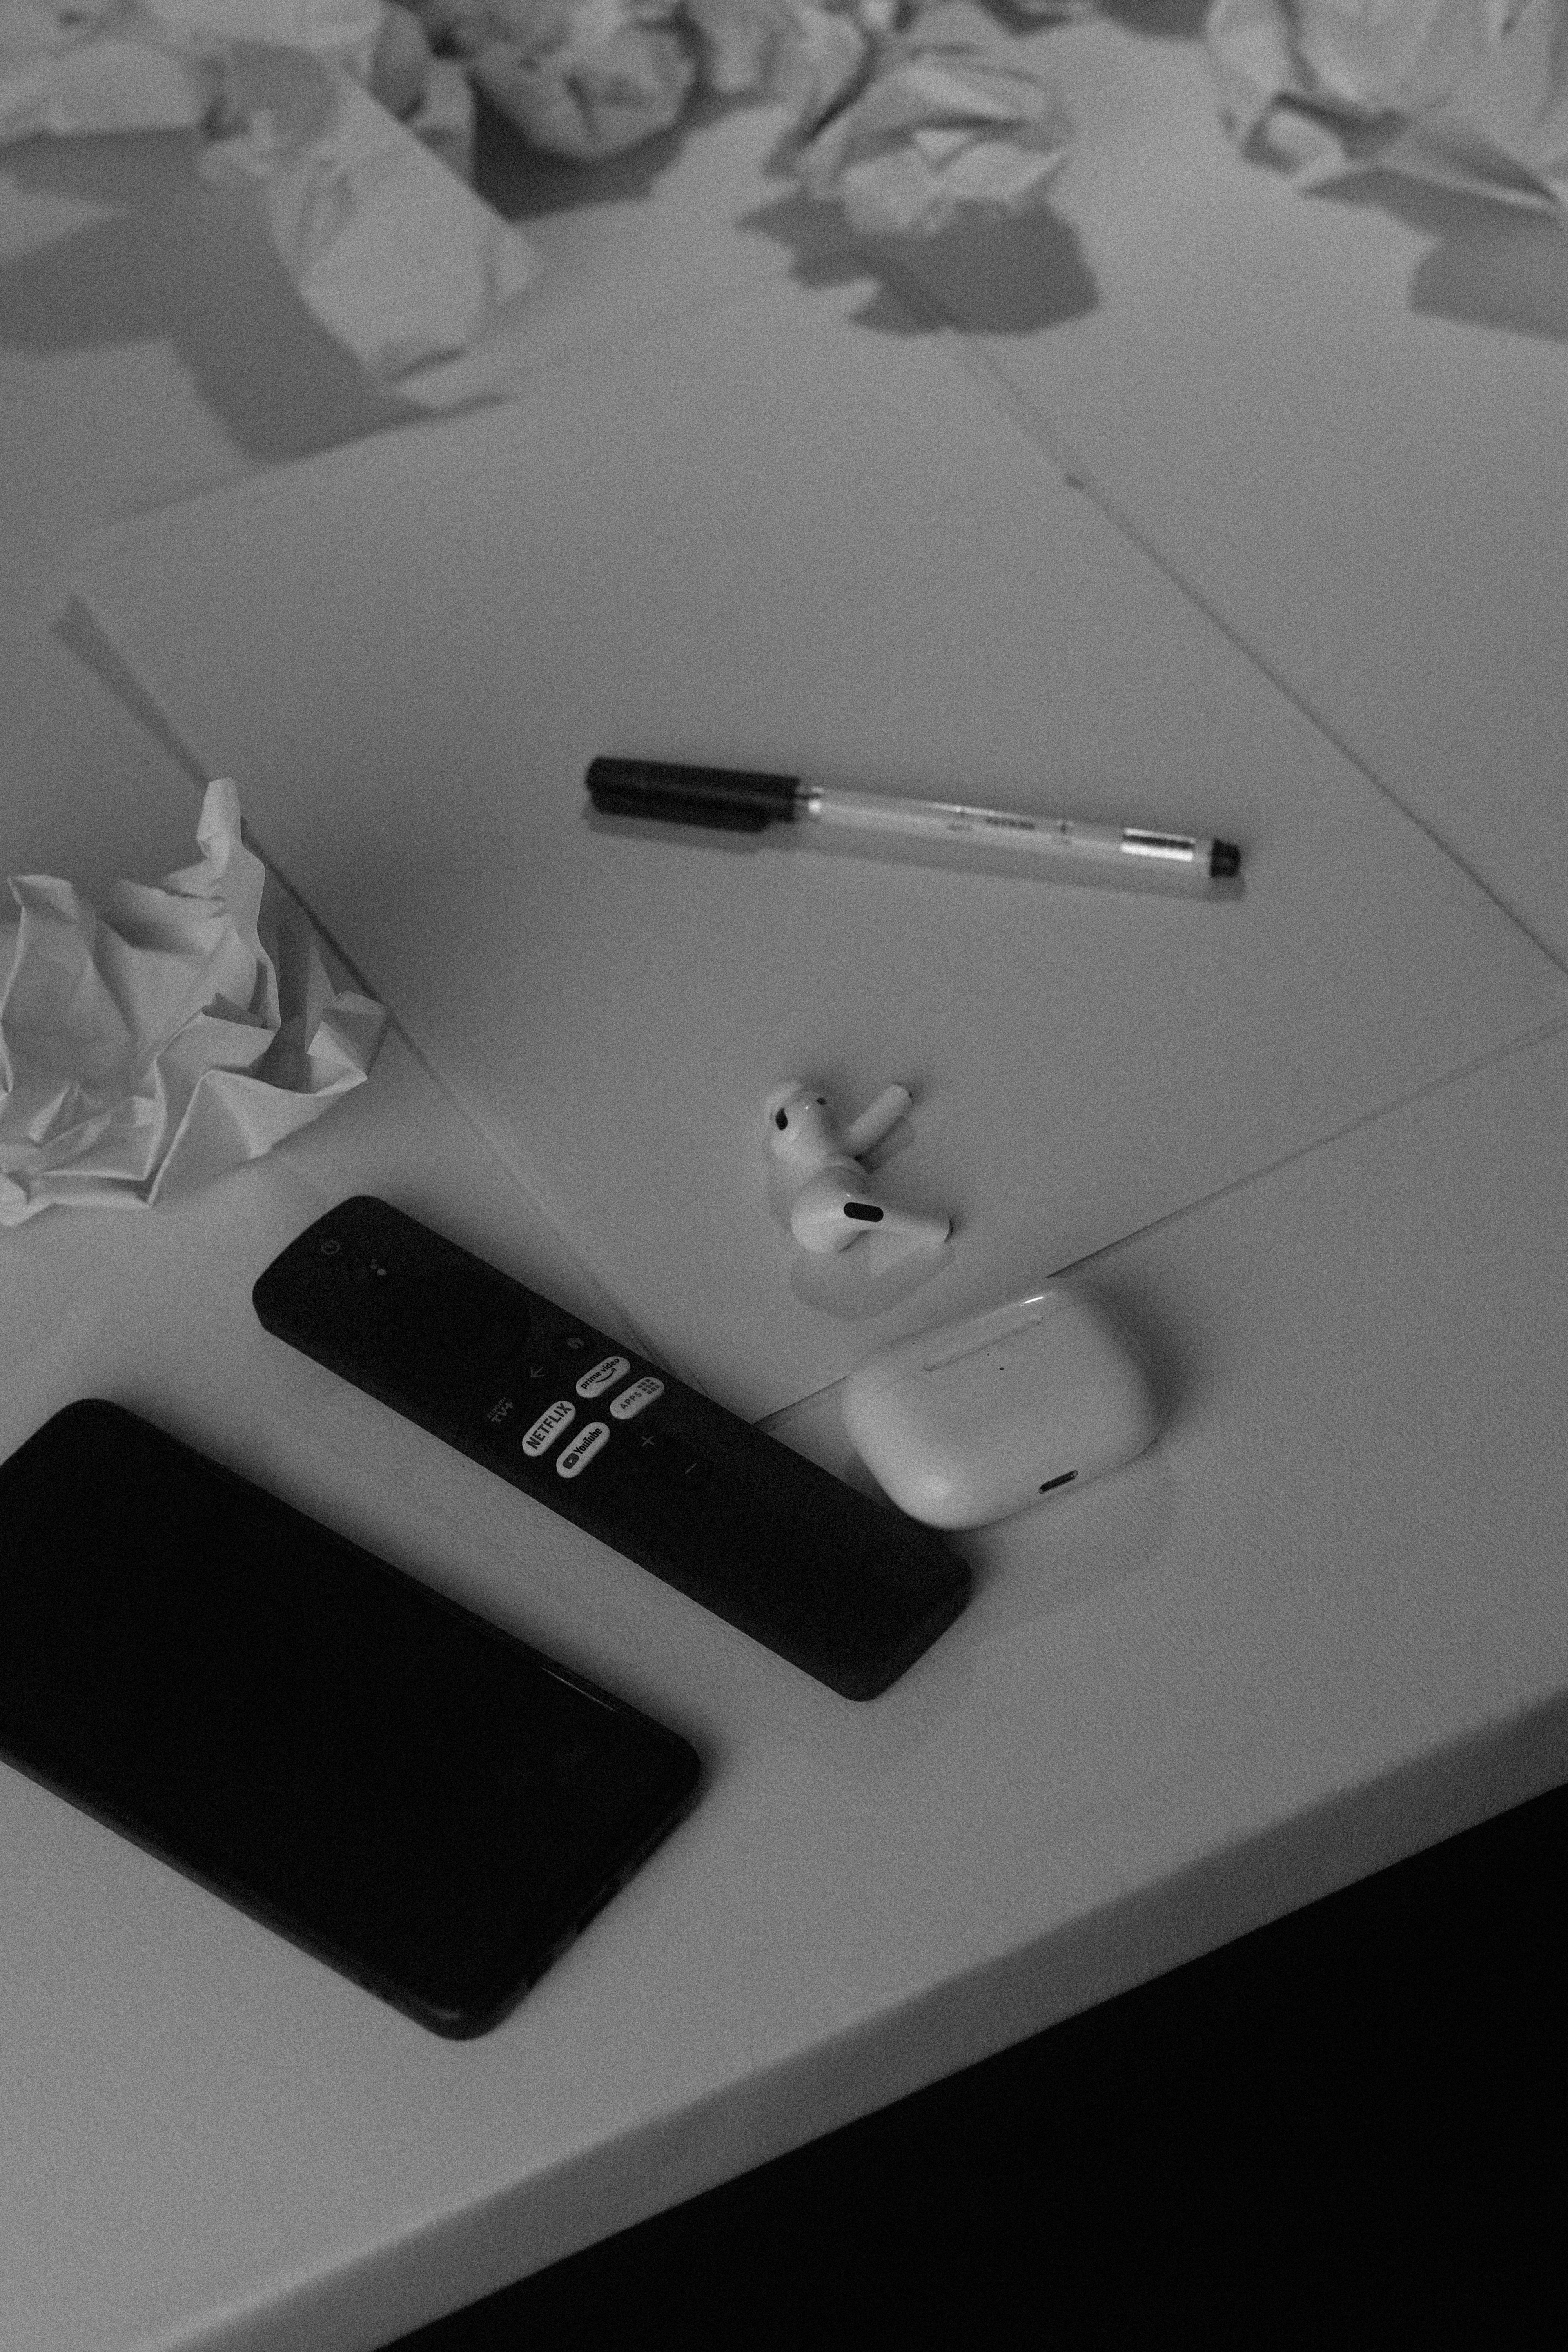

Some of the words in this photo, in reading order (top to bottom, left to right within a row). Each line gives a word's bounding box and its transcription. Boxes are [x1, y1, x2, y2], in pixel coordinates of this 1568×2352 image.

[581, 1372, 602, 1389] prime
[601, 1359, 620, 1372] video
[620, 1391, 642, 1410] APPS
[526, 1403, 572, 1450] NETFLIX
[573, 1428, 603, 1455] YouTube
